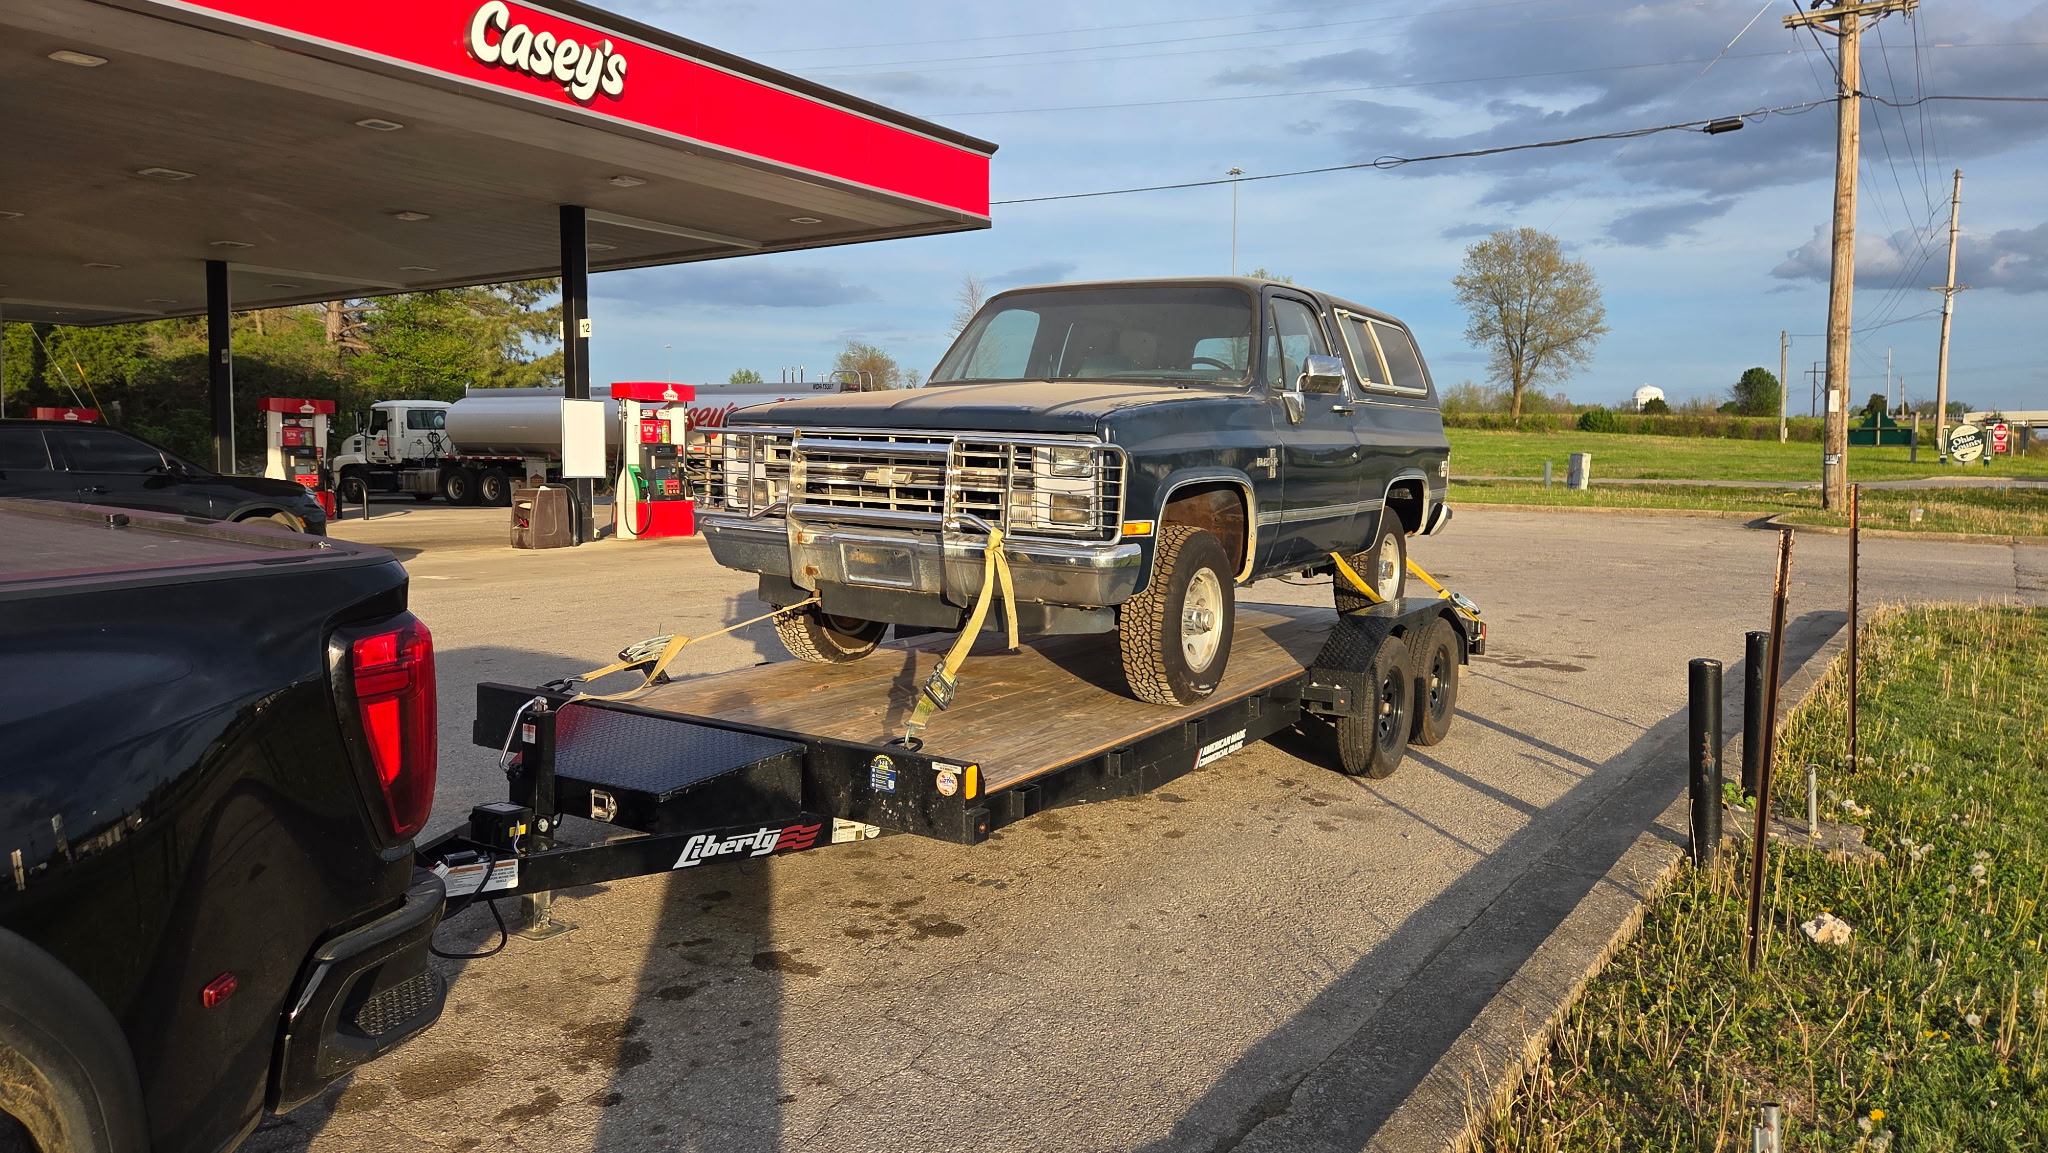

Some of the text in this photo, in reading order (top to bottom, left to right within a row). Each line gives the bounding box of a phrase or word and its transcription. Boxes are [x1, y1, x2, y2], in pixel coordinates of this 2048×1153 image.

[466, 0, 628, 101] Casey's
[581, 323, 591, 333] 12
[1951, 439, 1983, 452] County
[1953, 435, 1975, 446] Ohio
[1202, 736, 1231, 756] AMERICAN
[673, 827, 782, 870] Liberty
